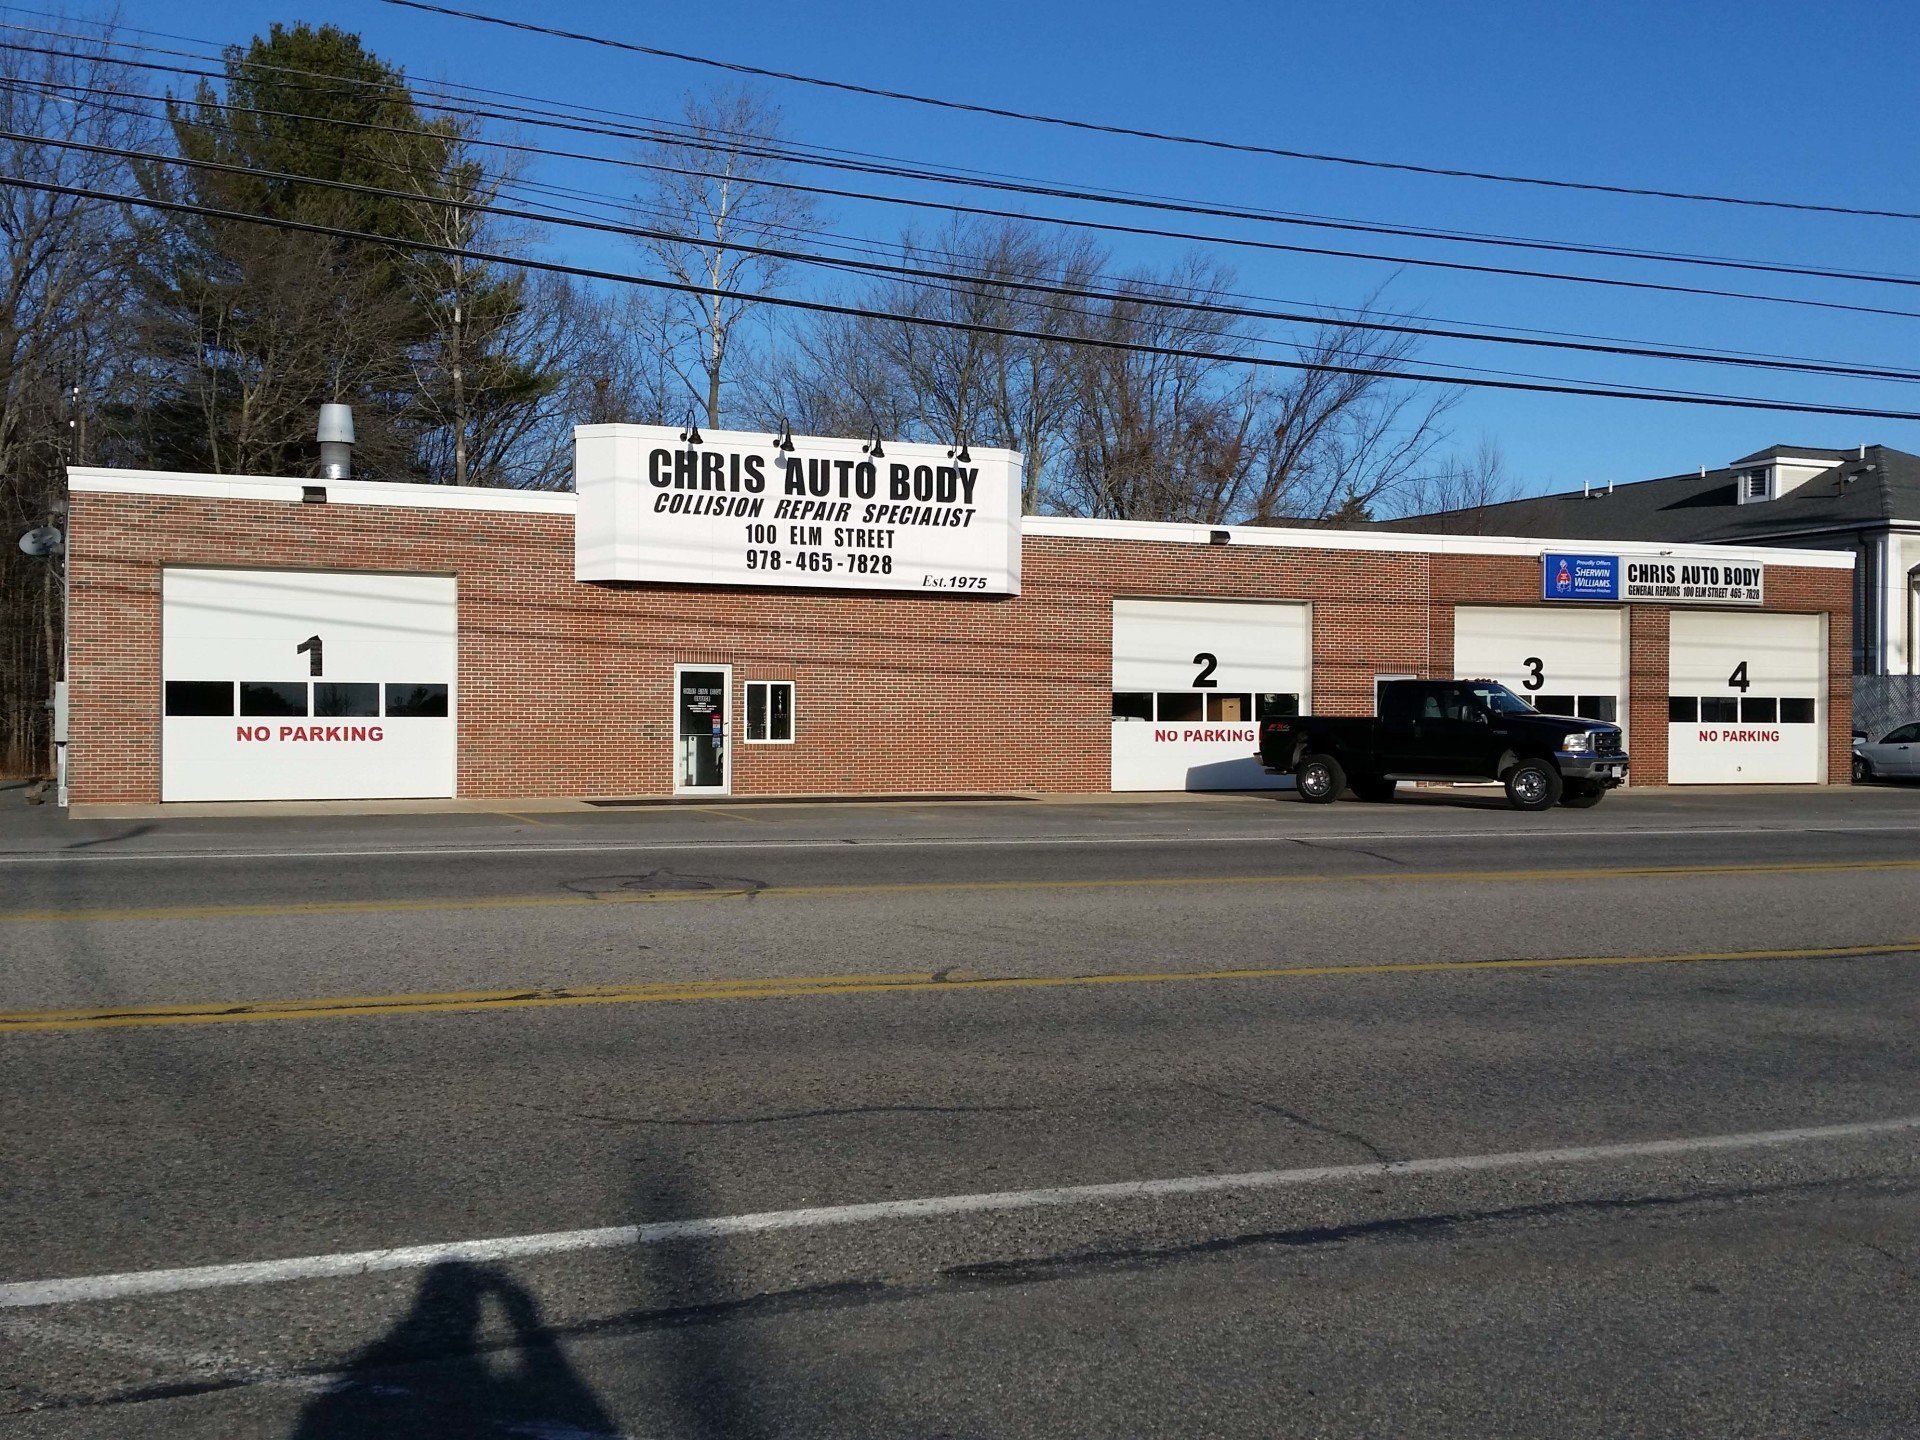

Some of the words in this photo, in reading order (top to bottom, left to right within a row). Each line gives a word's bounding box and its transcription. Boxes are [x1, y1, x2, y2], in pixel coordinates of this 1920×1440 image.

[649, 448, 765, 494] CHRIS
[784, 457, 876, 500] AUTO
[889, 463, 979, 505] BODY
[653, 492, 764, 518] COLLISION
[773, 499, 852, 522] REPAIR
[862, 503, 976, 528] SPECIALIST
[745, 523, 777, 545] 100
[790, 525, 822, 546] ELM
[834, 527, 895, 549] STREET
[746, 549, 893, 575] 978-465-7828
[1575, 567, 1610, 577] SHERWIN
[1627, 563, 1676, 584] CHRIS
[1681, 565, 1719, 585] AUTO
[1723, 566, 1760, 587] BODY
[1628, 585, 1654, 596] GENERAL
[1655, 585, 1680, 597] REPAIRS
[1683, 586, 1695, 598] 100
[1695, 586, 1707, 598] ELM
[1707, 587, 1728, 599] STREET
[296, 634, 323, 677] 1
[1192, 652, 1218, 688] 2
[1522, 657, 1544, 690] 3
[1728, 661, 1750, 693] 4
[236, 726, 271, 742] NO
[279, 726, 384, 742] PARKING
[1154, 729, 1178, 743] NO
[1183, 729, 1255, 743] PARKING
[1699, 730, 1718, 742] NO
[1722, 730, 1780, 742] PARKING
